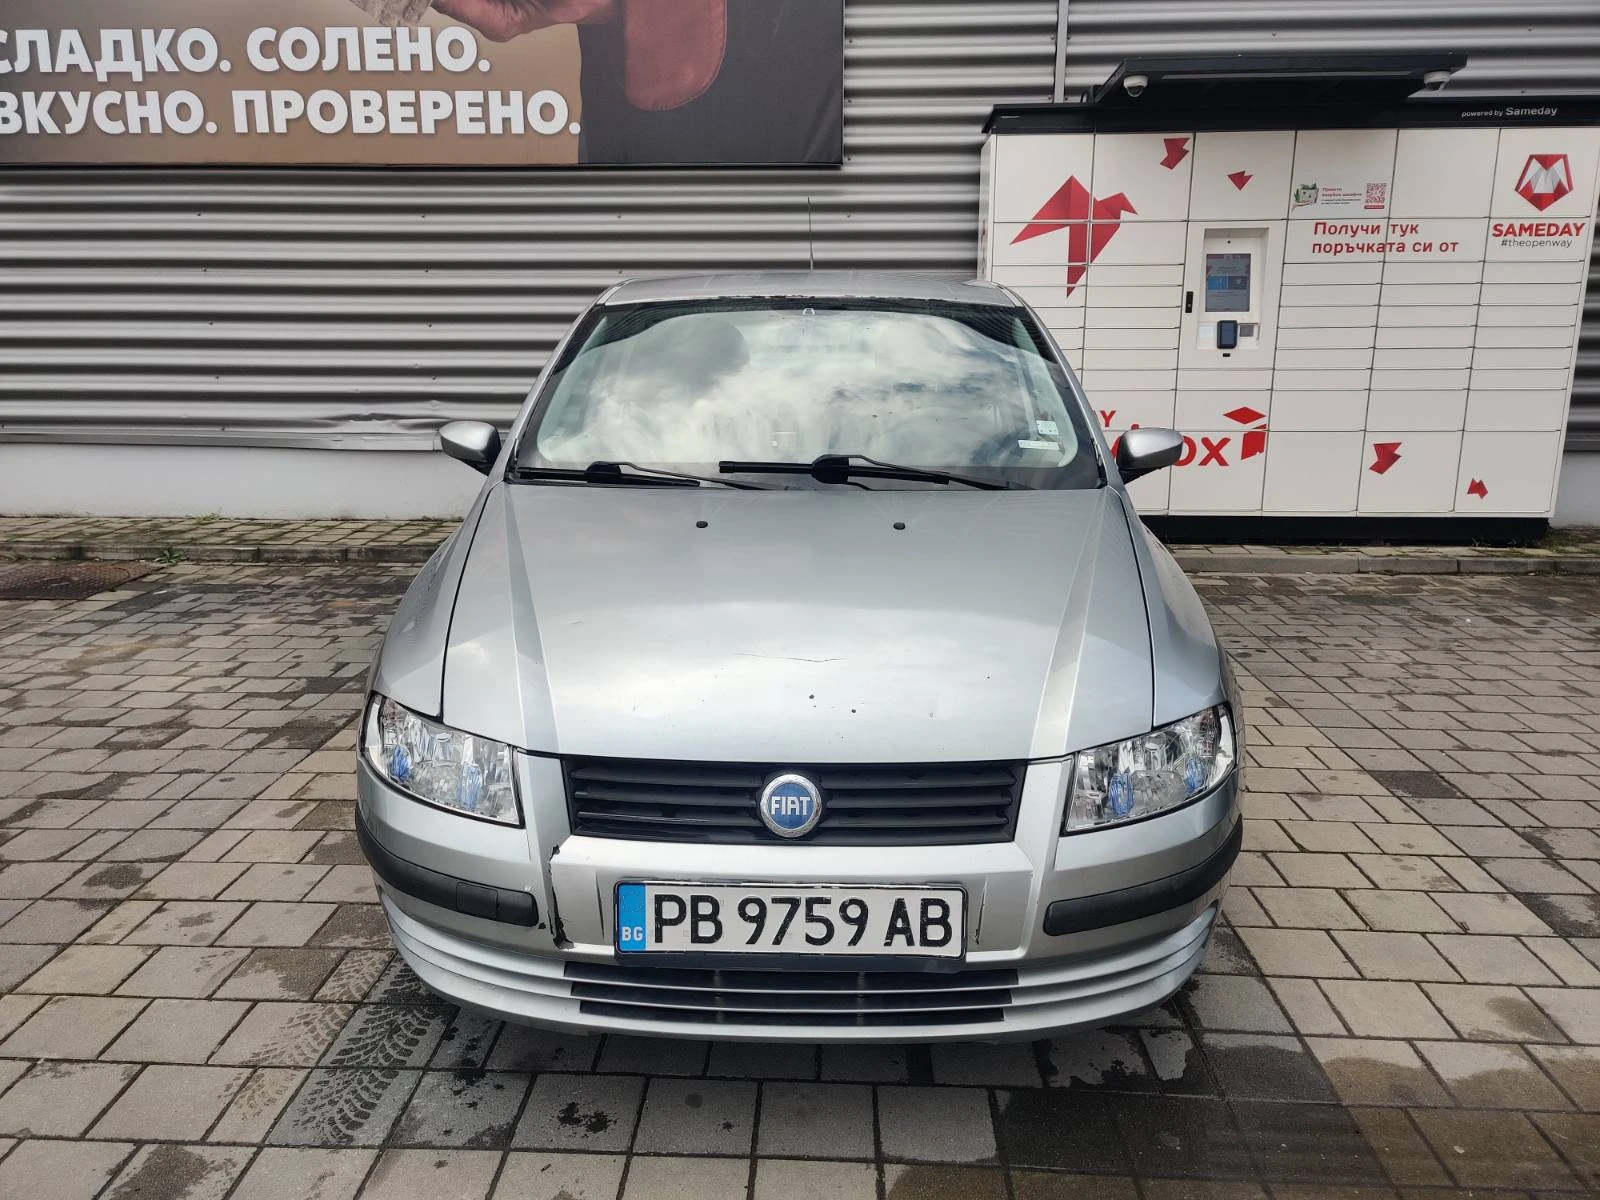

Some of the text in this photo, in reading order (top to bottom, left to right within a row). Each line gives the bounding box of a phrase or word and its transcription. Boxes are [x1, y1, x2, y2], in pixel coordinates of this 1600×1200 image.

[246, 26, 490, 73] СОЛЕНО.
[0, 89, 581, 135] ВКУСНО. ПРОВЕРЕНО.
[1461, 106, 1558, 118] powered by Sameday
[1314, 221, 1419, 238] Получи тук
[1492, 222, 1586, 238] SAMEDAY
[1312, 240, 1460, 256] поръчката си от
[1500, 237, 1573, 249] #theopenway
[771, 796, 811, 816] FIAT
[653, 894, 953, 948] PB 9759 AB
[621, 926, 643, 942] BG
